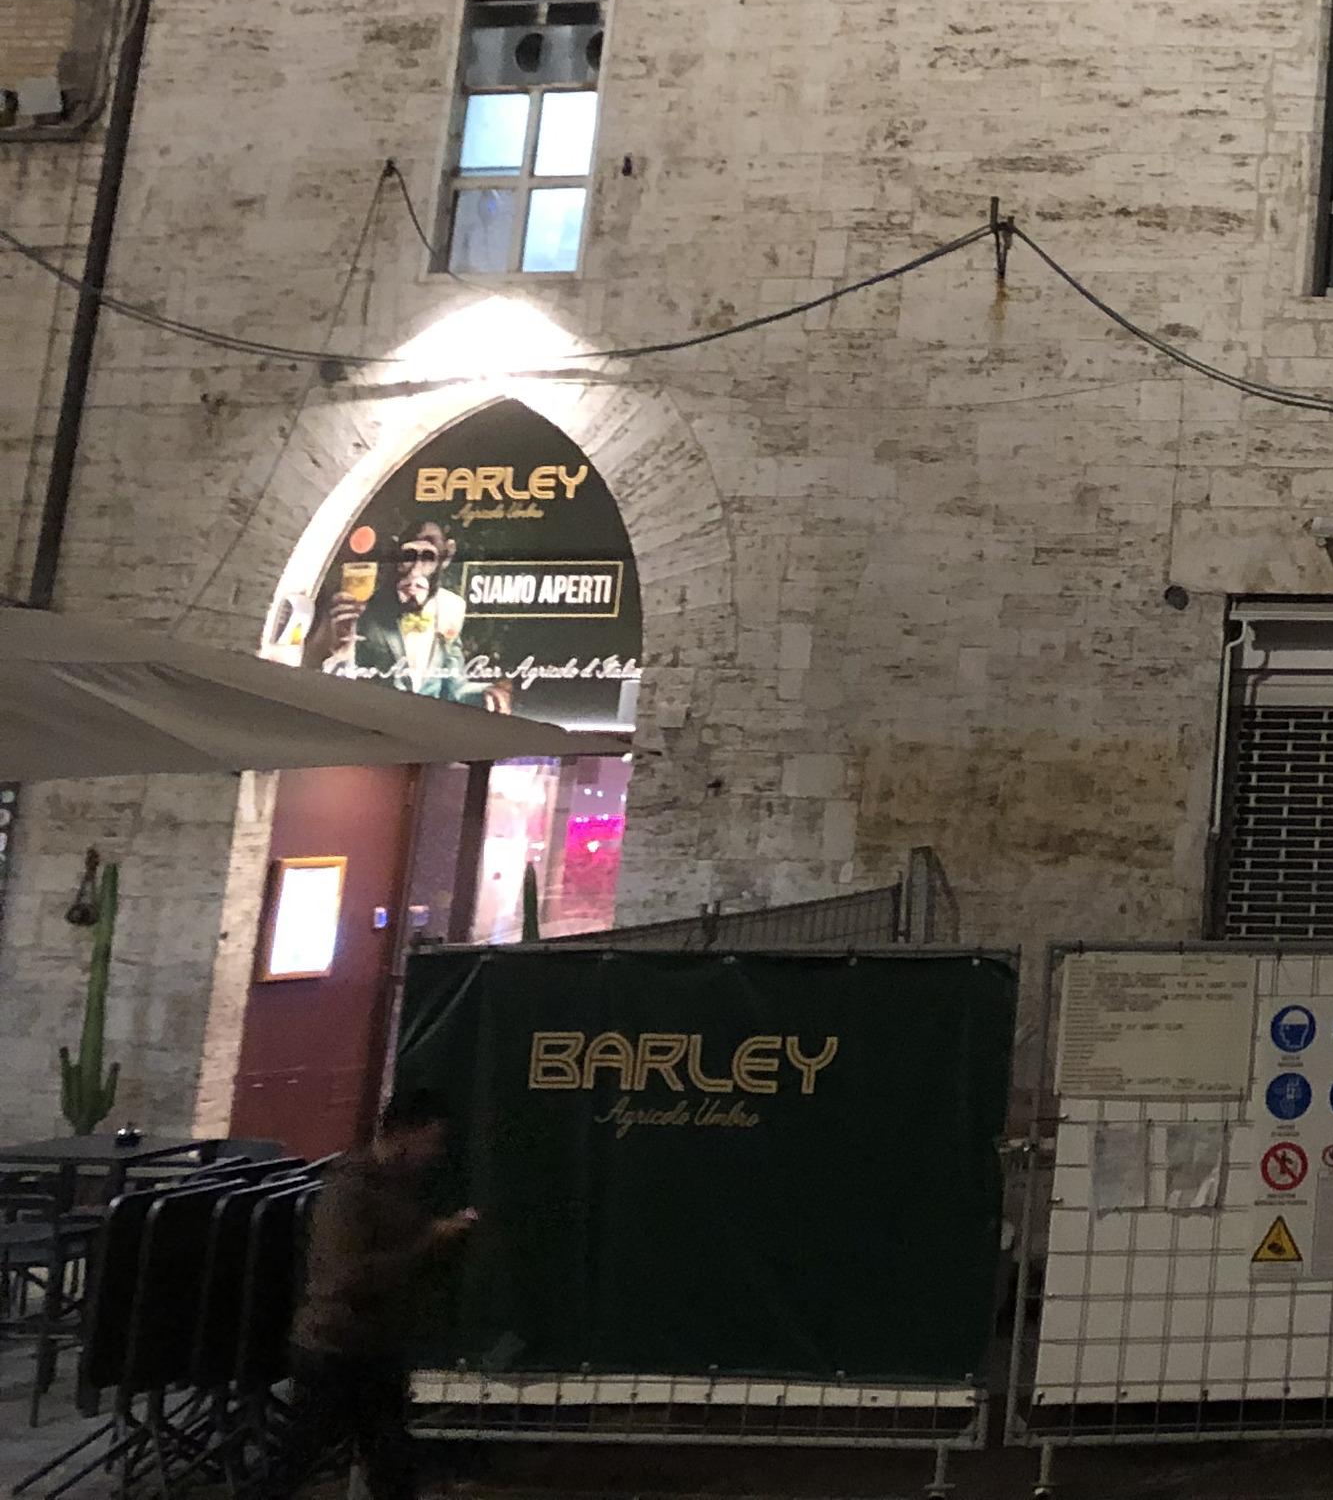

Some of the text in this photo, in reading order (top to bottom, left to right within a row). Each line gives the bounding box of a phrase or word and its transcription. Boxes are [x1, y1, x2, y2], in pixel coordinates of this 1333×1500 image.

[414, 465, 589, 502] BARLEY
[469, 574, 612, 604] SIAMO APERTI
[527, 1031, 840, 1096] BARLEY
